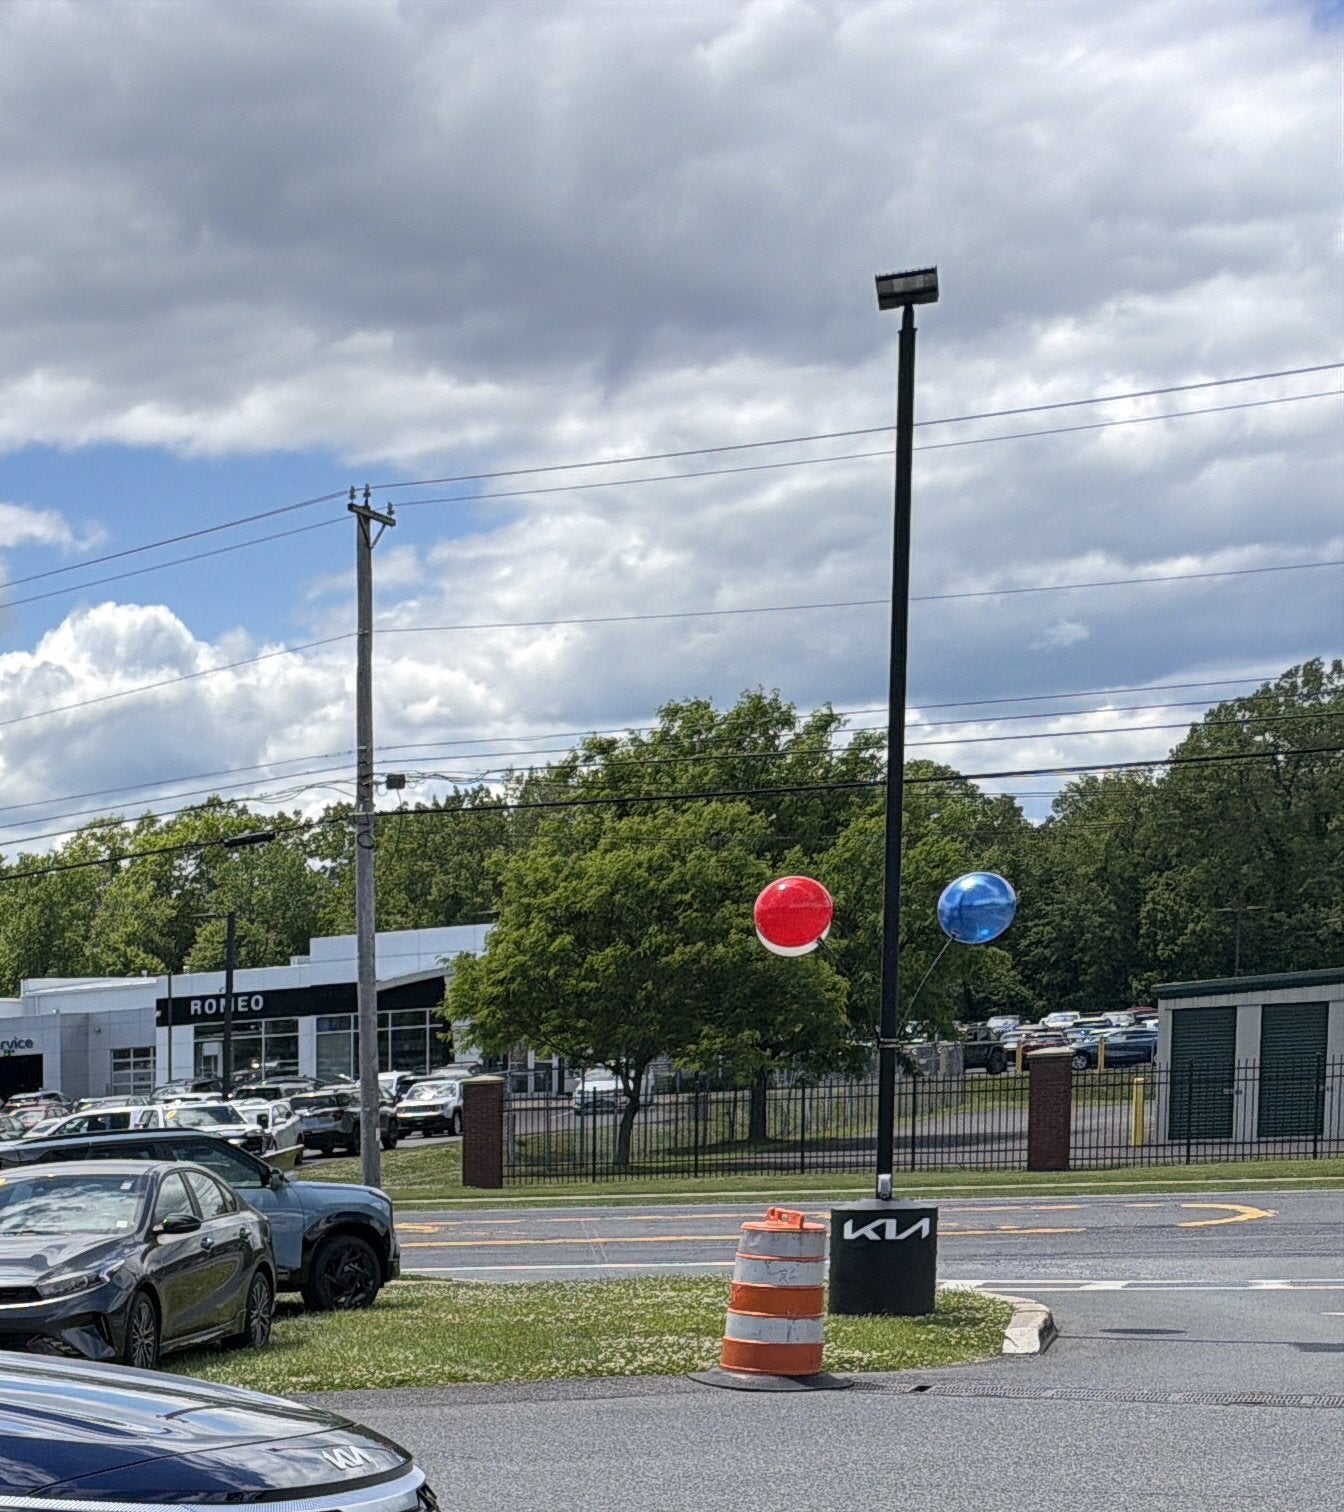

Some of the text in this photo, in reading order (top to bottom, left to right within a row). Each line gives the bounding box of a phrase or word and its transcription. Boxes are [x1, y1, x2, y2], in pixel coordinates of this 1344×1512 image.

[190, 995, 264, 1016] ROMEO
[843, 1217, 930, 1240] KIA
[321, 1445, 380, 1470] KIA
